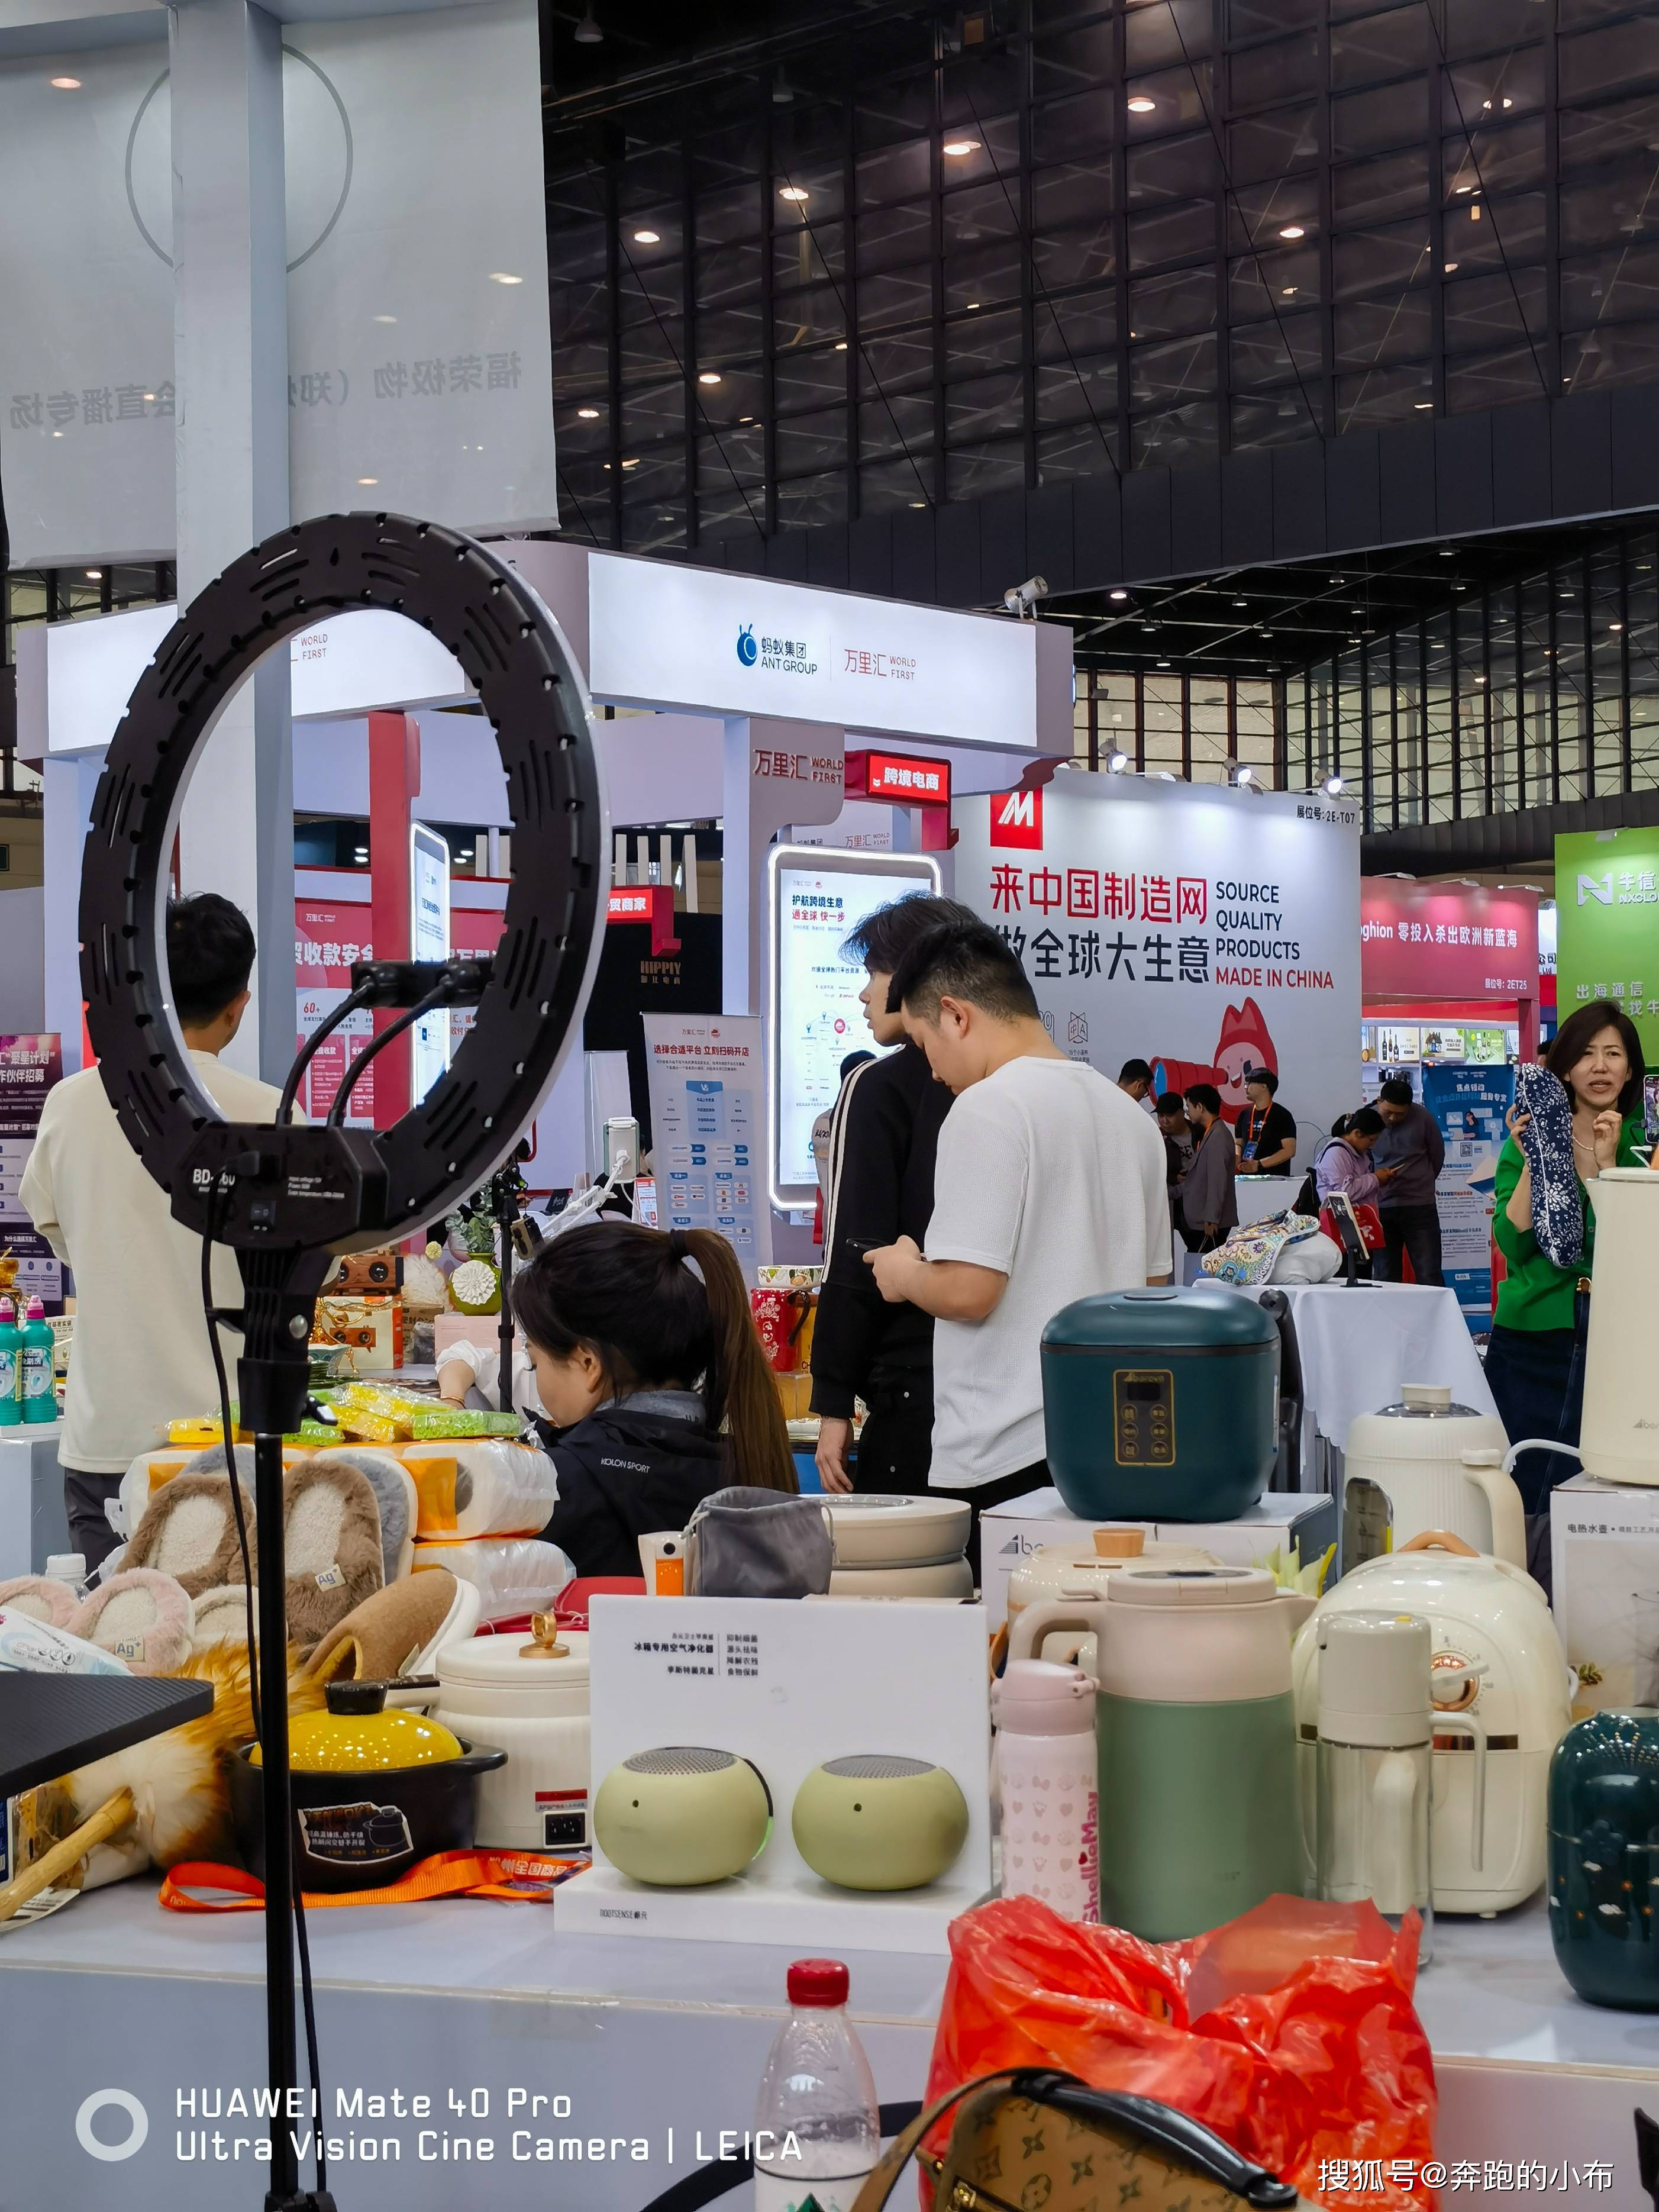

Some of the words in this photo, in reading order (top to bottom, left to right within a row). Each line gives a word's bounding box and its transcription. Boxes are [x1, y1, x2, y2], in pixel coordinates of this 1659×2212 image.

[301, 634, 328, 647] WORLD
[761, 636, 806, 659] 蚂蚁集团
[302, 647, 327, 660] FIRST
[890, 655, 916, 668] WORLD
[761, 656, 781, 670] ANT
[783, 660, 818, 675] GROUP
[844, 649, 887, 678] 万里汇
[890, 669, 915, 681] FIRST
[753, 749, 808, 781] 万里汇
[810, 755, 844, 770] WORLD
[812, 770, 842, 785] FIRST
[883, 766, 940, 791] 跨境电商
[845, 834, 872, 848] 万里汇
[990, 863, 1208, 925] 来中国制造网
[1216, 881, 1280, 904] SOURCE
[792, 894, 844, 908] 护航跨境生意
[305, 913, 324, 922] 万里汇
[1216, 909, 1282, 931] QUALITY
[1397, 921, 1518, 948] 零投入杀出欧洲新蓝海
[1216, 937, 1300, 960] PRODUCTS
[1216, 966, 1263, 987] MADE
[1267, 968, 1283, 987] IN
[1286, 969, 1334, 989] CHINA
[1576, 981, 1644, 1000] 出海通信
[653, 1044, 702, 1056] 选择合适平台
[703, 1044, 750, 1057] 立刻扫码开店
[601, 1458, 626, 1468] KOLON
[627, 1461, 651, 1474] SPORT
[1567, 1523, 1608, 1534] 电热水壶
[634, 1642, 714, 1653] 冰箱专用空气净化器
